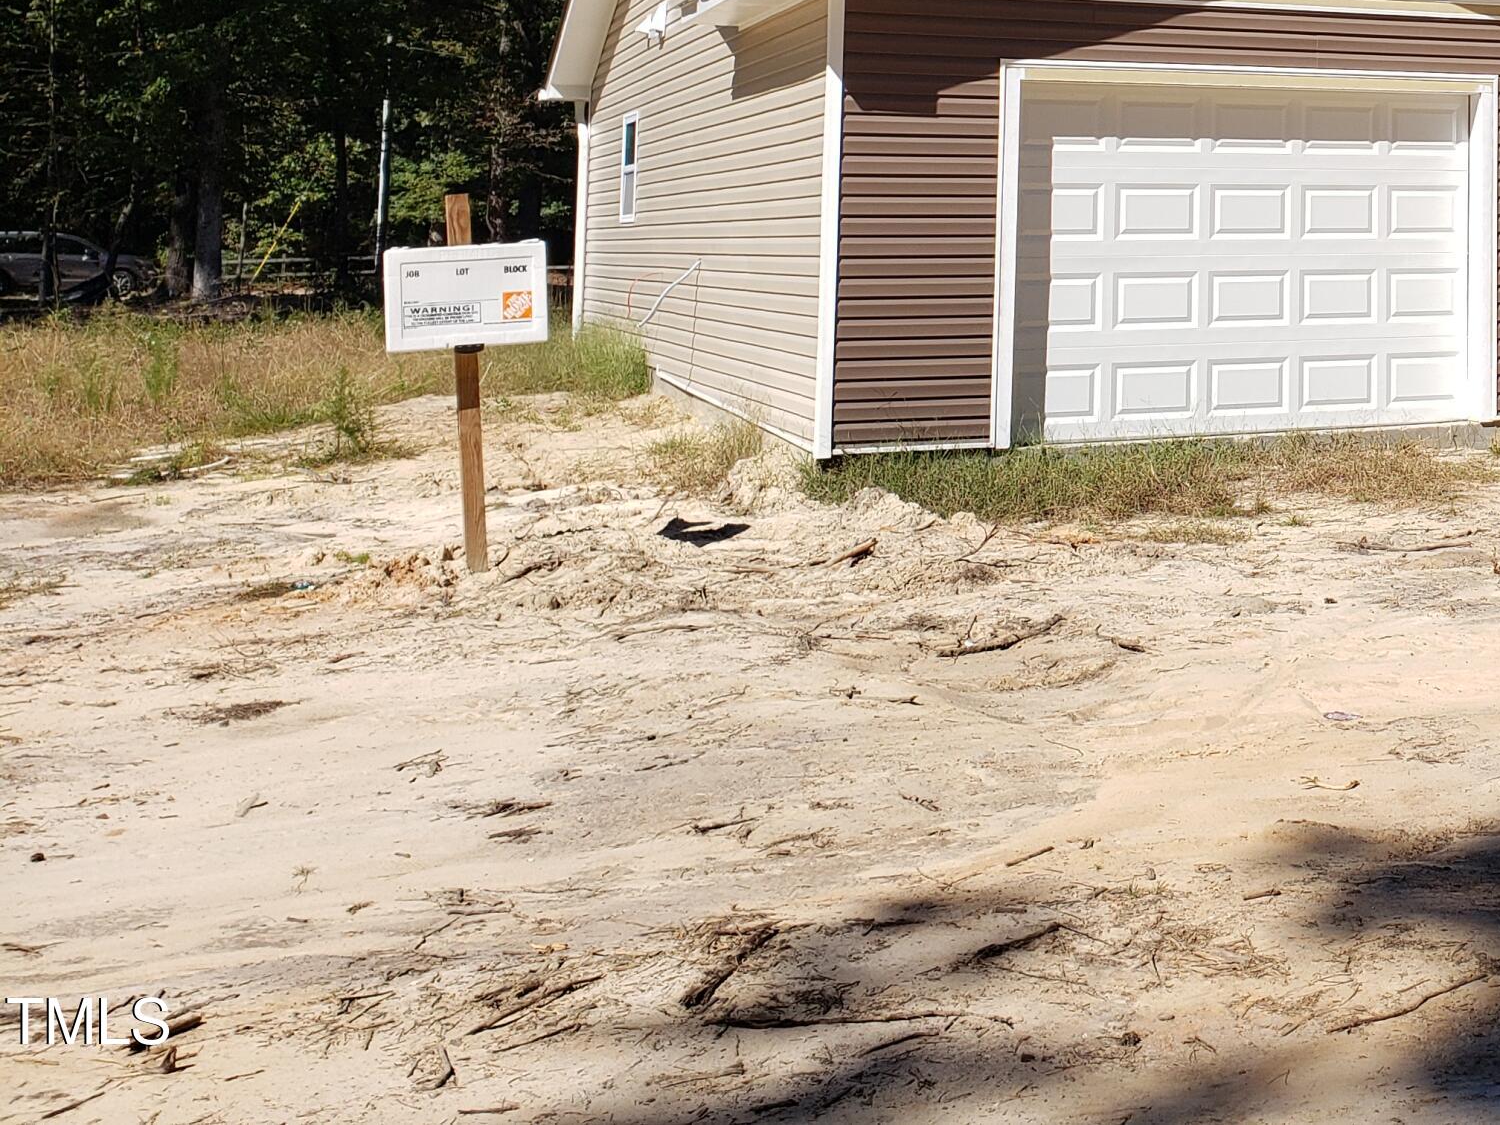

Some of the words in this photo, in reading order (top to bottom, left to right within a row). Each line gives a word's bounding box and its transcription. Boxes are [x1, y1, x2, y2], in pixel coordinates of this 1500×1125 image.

[405, 270, 420, 278] JOB
[504, 265, 527, 273] BLOCK
[410, 304, 475, 314] WARNING!
